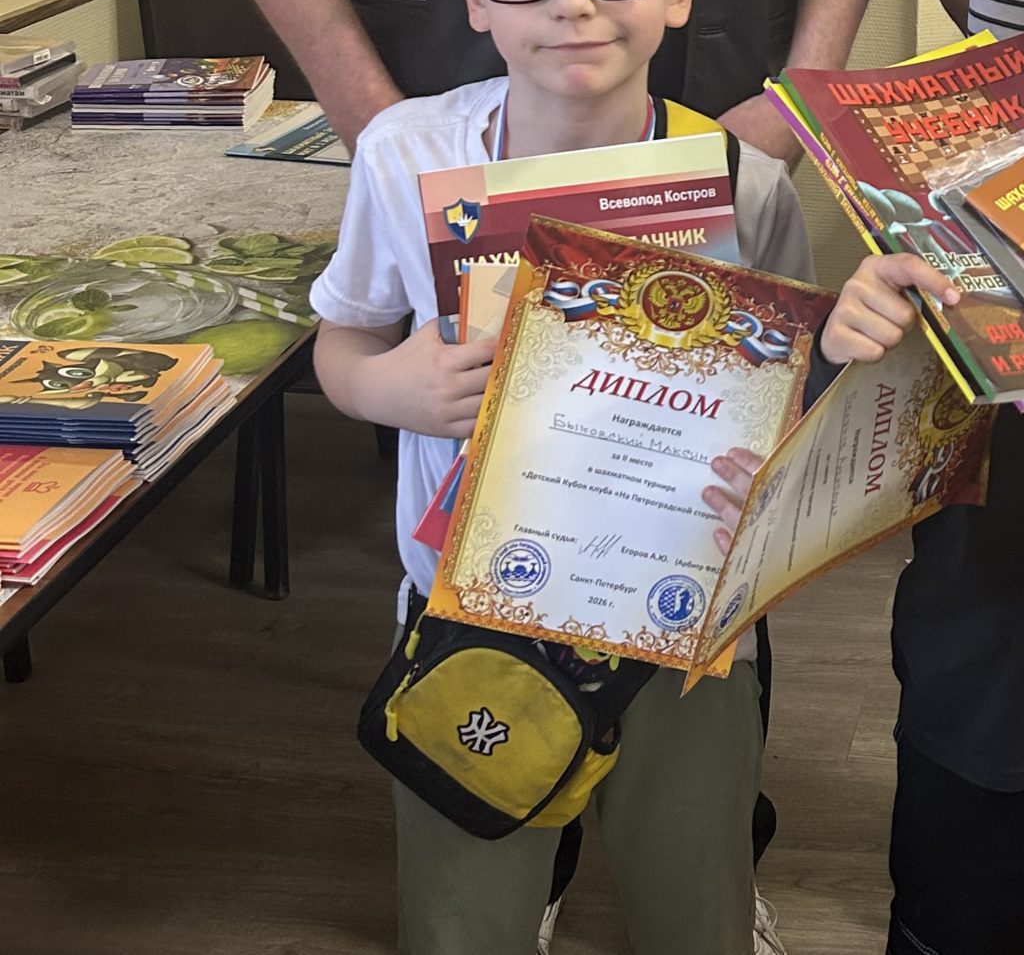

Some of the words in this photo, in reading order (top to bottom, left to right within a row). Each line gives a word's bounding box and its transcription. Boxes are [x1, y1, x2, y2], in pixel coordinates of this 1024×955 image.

[599, 194, 663, 211] Всеволод
[663, 187, 717, 203] Костров
[991, 355, 1009, 374] И
[570, 367, 724, 420] ДИПЛОМ
[611, 413, 683, 437] Награждается
[864, 383, 897, 497] ДИПЛОМ
[629, 456, 654, 468] место
[594, 467, 642, 485] шахматном
[643, 478, 677, 493] турнире
[521, 470, 561, 485] «Детский
[562, 477, 588, 490] Кубок
[588, 484, 614, 496] клуба
[631, 493, 693, 515] Петроградской
[693, 509, 725, 523] сторон
[513, 523, 551, 538] Главный
[620, 545, 649, 559] Егоров
[674, 557, 705, 572] (Арбитр
[569, 573, 639, 595] Санкт-Петербург
